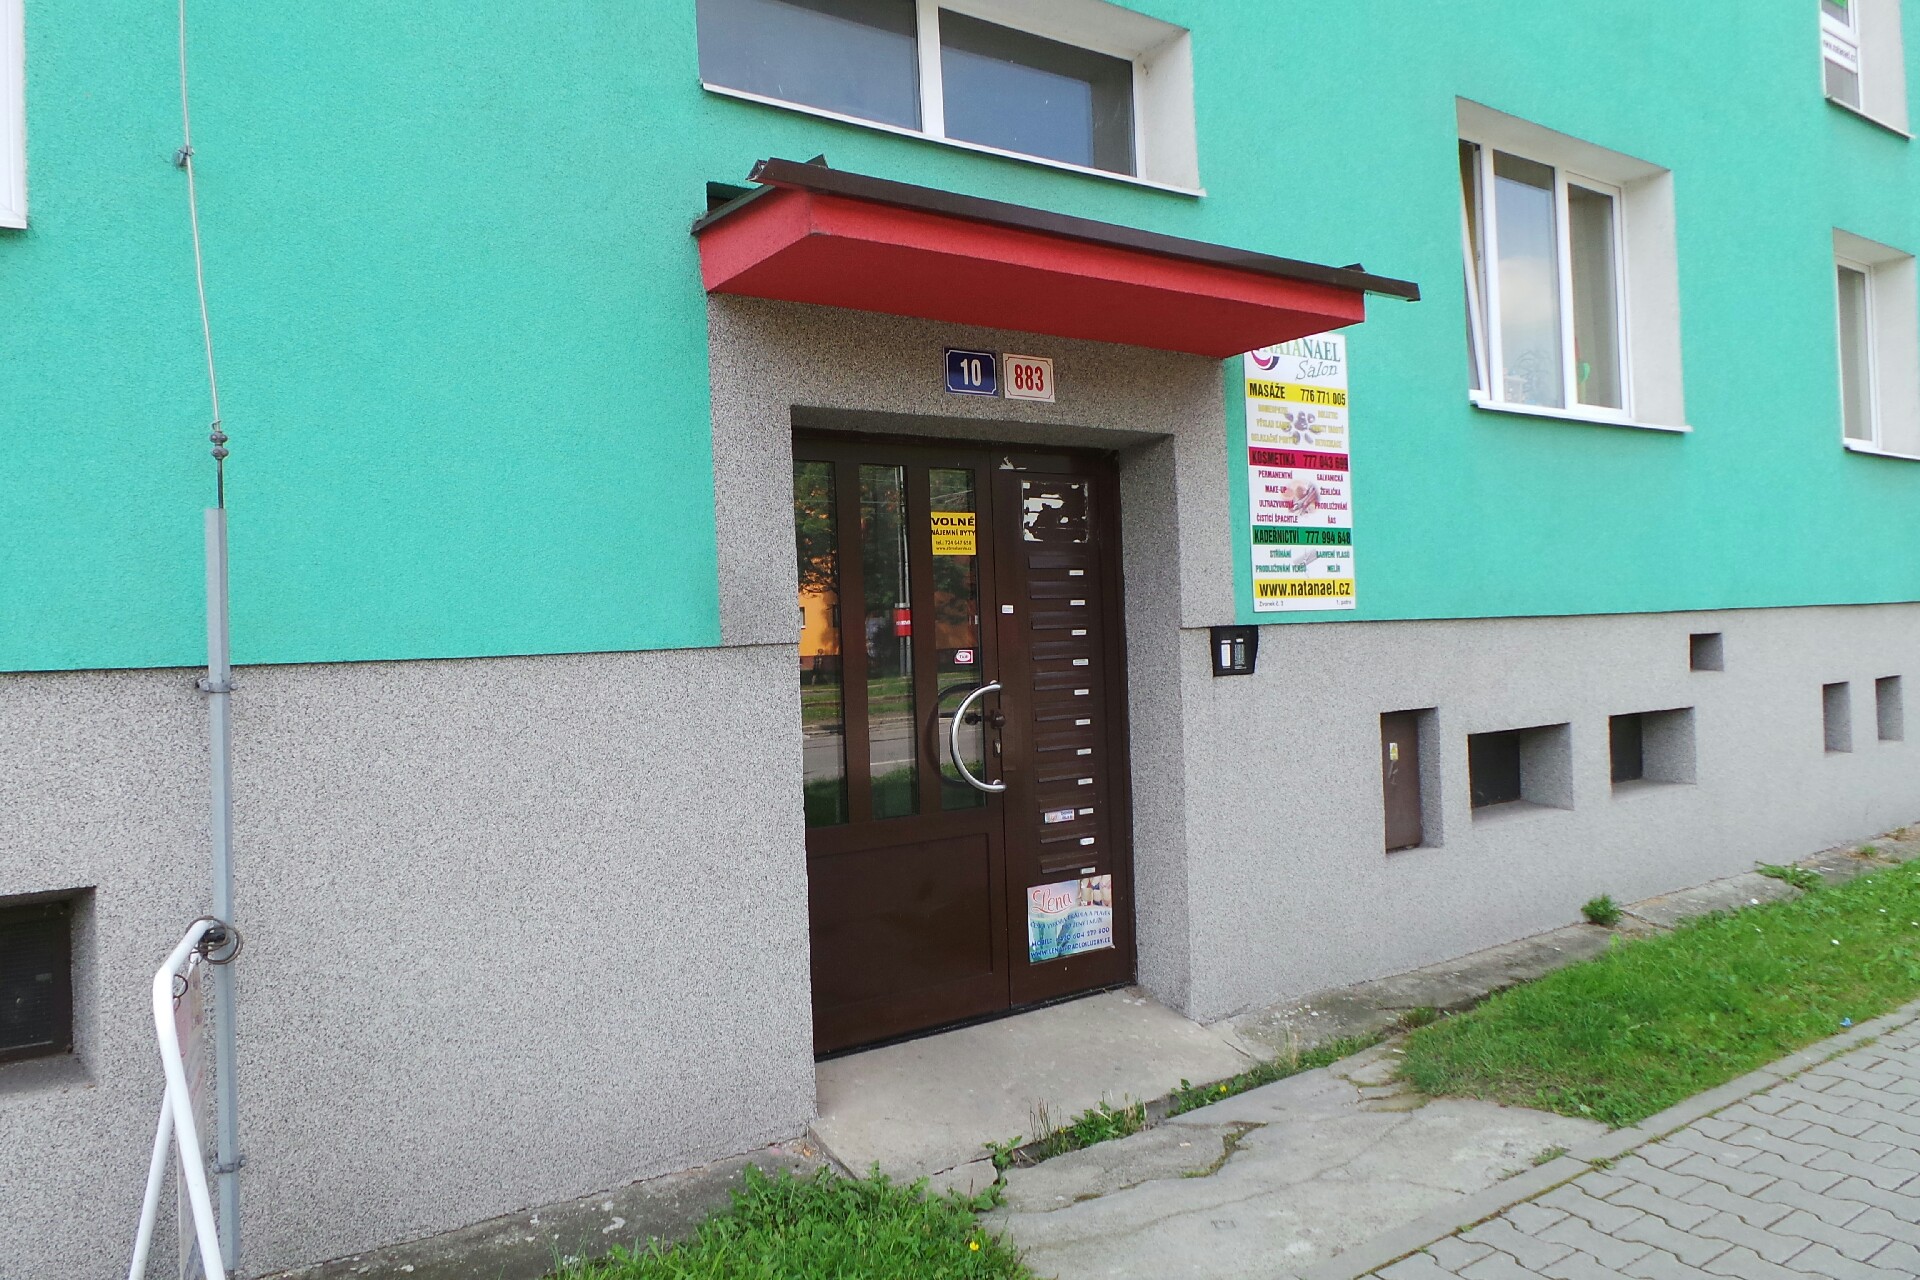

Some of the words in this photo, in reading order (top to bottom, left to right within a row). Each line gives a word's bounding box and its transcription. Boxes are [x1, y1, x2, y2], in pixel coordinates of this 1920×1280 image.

[960, 359, 982, 386] 10
[1014, 364, 1044, 391] 883
[1295, 359, 1338, 381] Salon
[1249, 382, 1286, 399] MASÁŽE
[1300, 388, 1315, 402] 776
[1317, 390, 1331, 404] 771
[1332, 392, 1346, 406] 005
[1252, 450, 1296, 466] KOSMETIKA
[1303, 454, 1318, 468] 777
[1258, 470, 1293, 479] PERMANENTNÍ
[1320, 486, 1341, 496] ŽEHLIČKA
[931, 516, 975, 526] VOLNÉ
[1275, 514, 1299, 523] ŠPACHTLE
[931, 528, 959, 536] NÁJEMNÍ
[1254, 527, 1300, 544] KADEŘNICTVÍ
[1306, 531, 1320, 544] 777
[1322, 531, 1336, 544] 994
[1337, 532, 1351, 544] 648
[1259, 579, 1351, 597] www.natanael.cz
[1031, 888, 1072, 914] Lena
